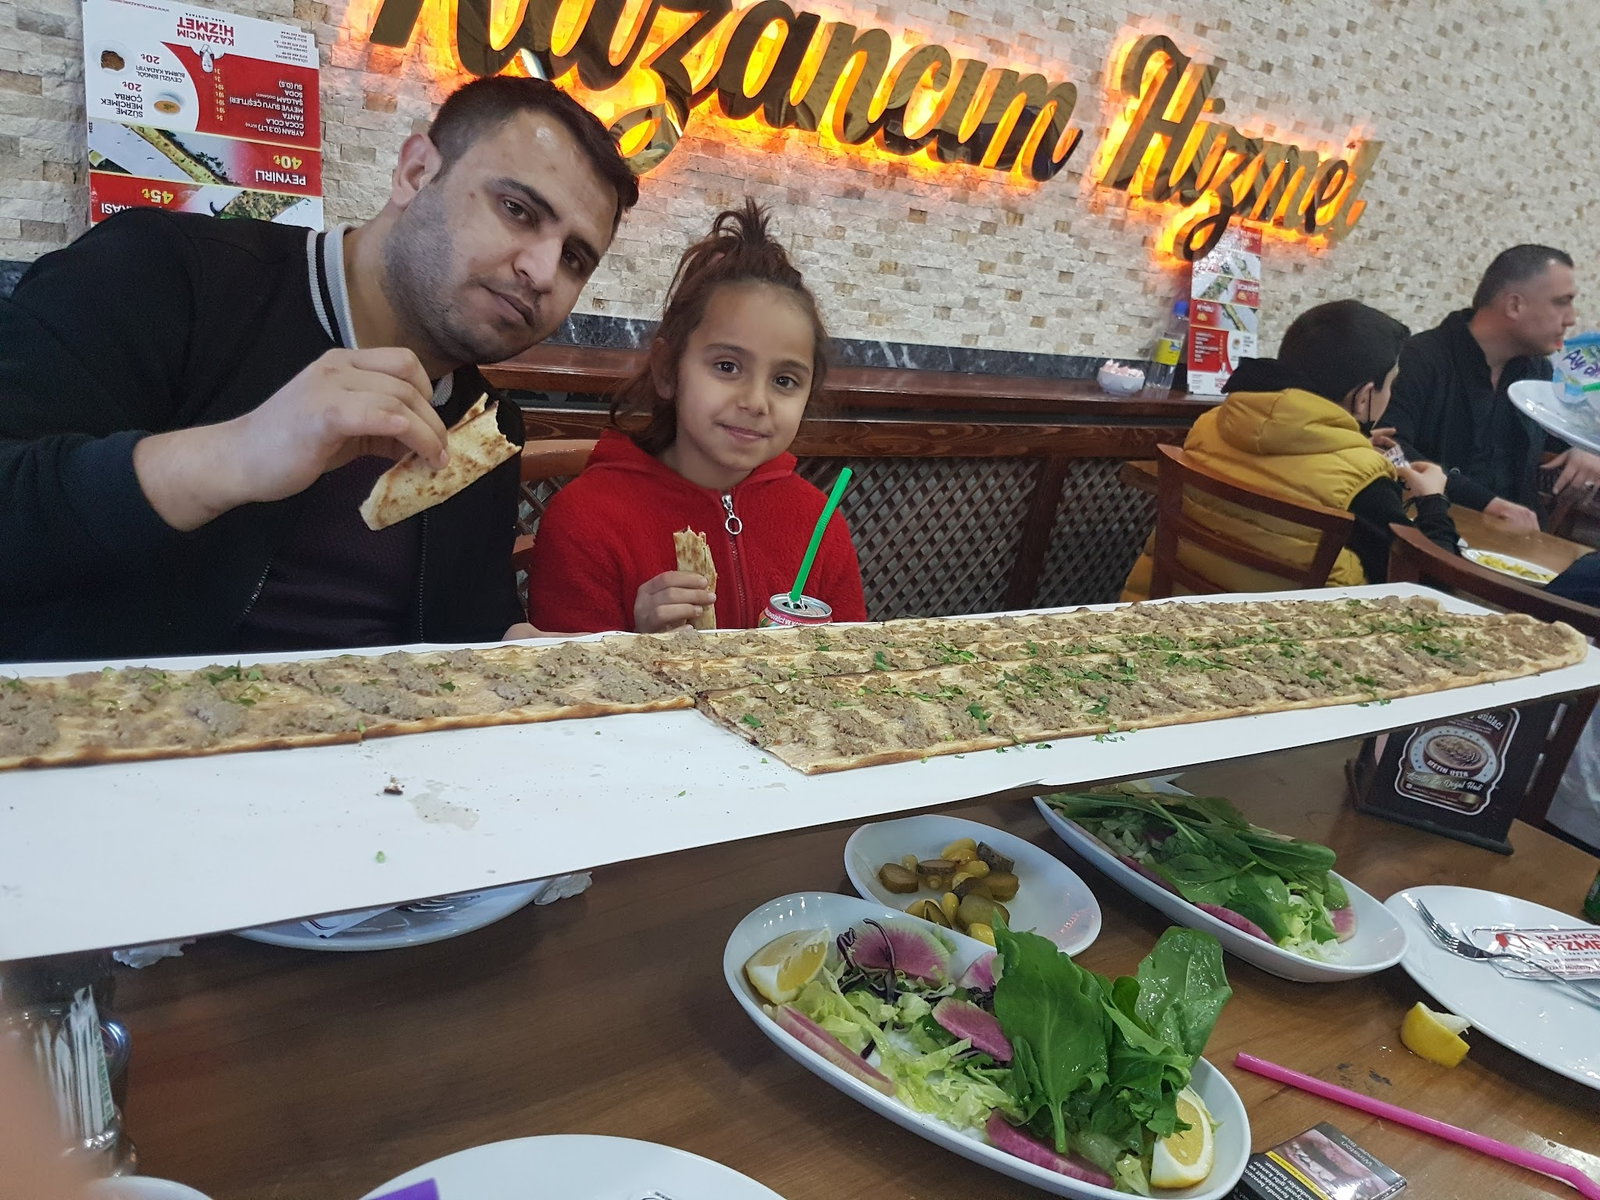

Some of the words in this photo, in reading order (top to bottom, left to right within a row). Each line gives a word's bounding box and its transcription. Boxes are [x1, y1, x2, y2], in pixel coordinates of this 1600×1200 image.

[176, 28, 234, 46] KAZANCIM
[114, 93, 143, 103] ÇORBA
[100, 98, 143, 111] MERCİMEK
[281, 105, 304, 113] MEYVE
[116, 108, 143, 118] SÜZME
[282, 113, 304, 122] FANTA
[266, 118, 284, 126] COLA
[285, 121, 304, 129] COCA
[282, 128, 304, 136] AYRAN
[255, 170, 307, 187] PEYNİRLİ
[1340, 1140, 1373, 1166] Winston
